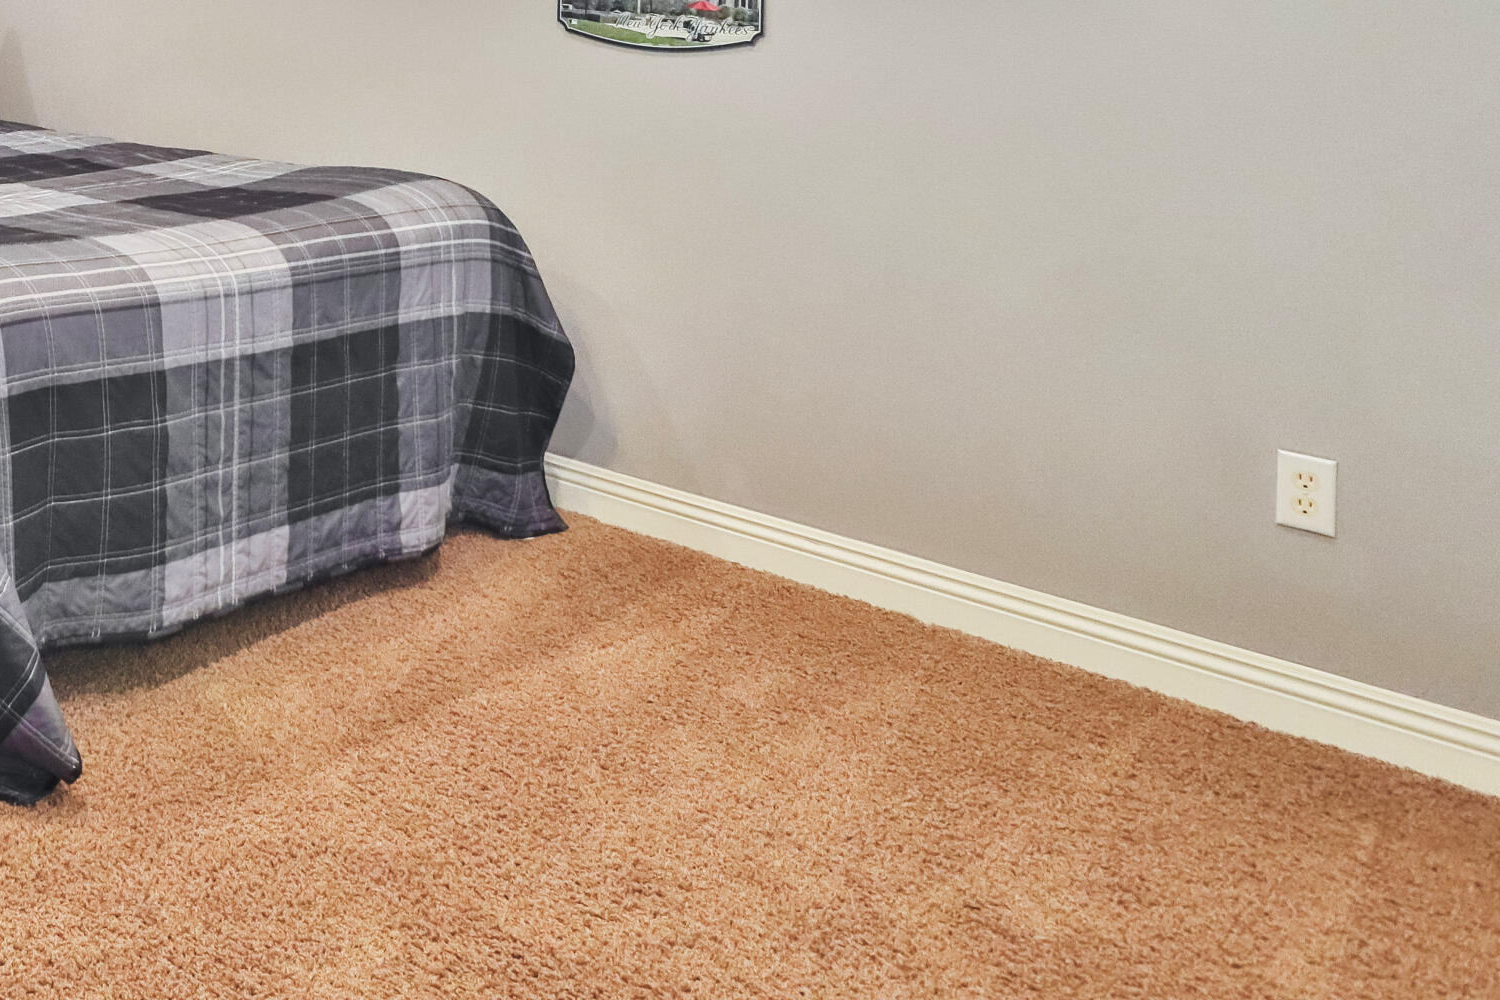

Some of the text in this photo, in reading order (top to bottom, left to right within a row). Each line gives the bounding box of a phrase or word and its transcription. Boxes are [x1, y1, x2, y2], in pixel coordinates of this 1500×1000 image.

[615, 13, 750, 39] New York Yankees
